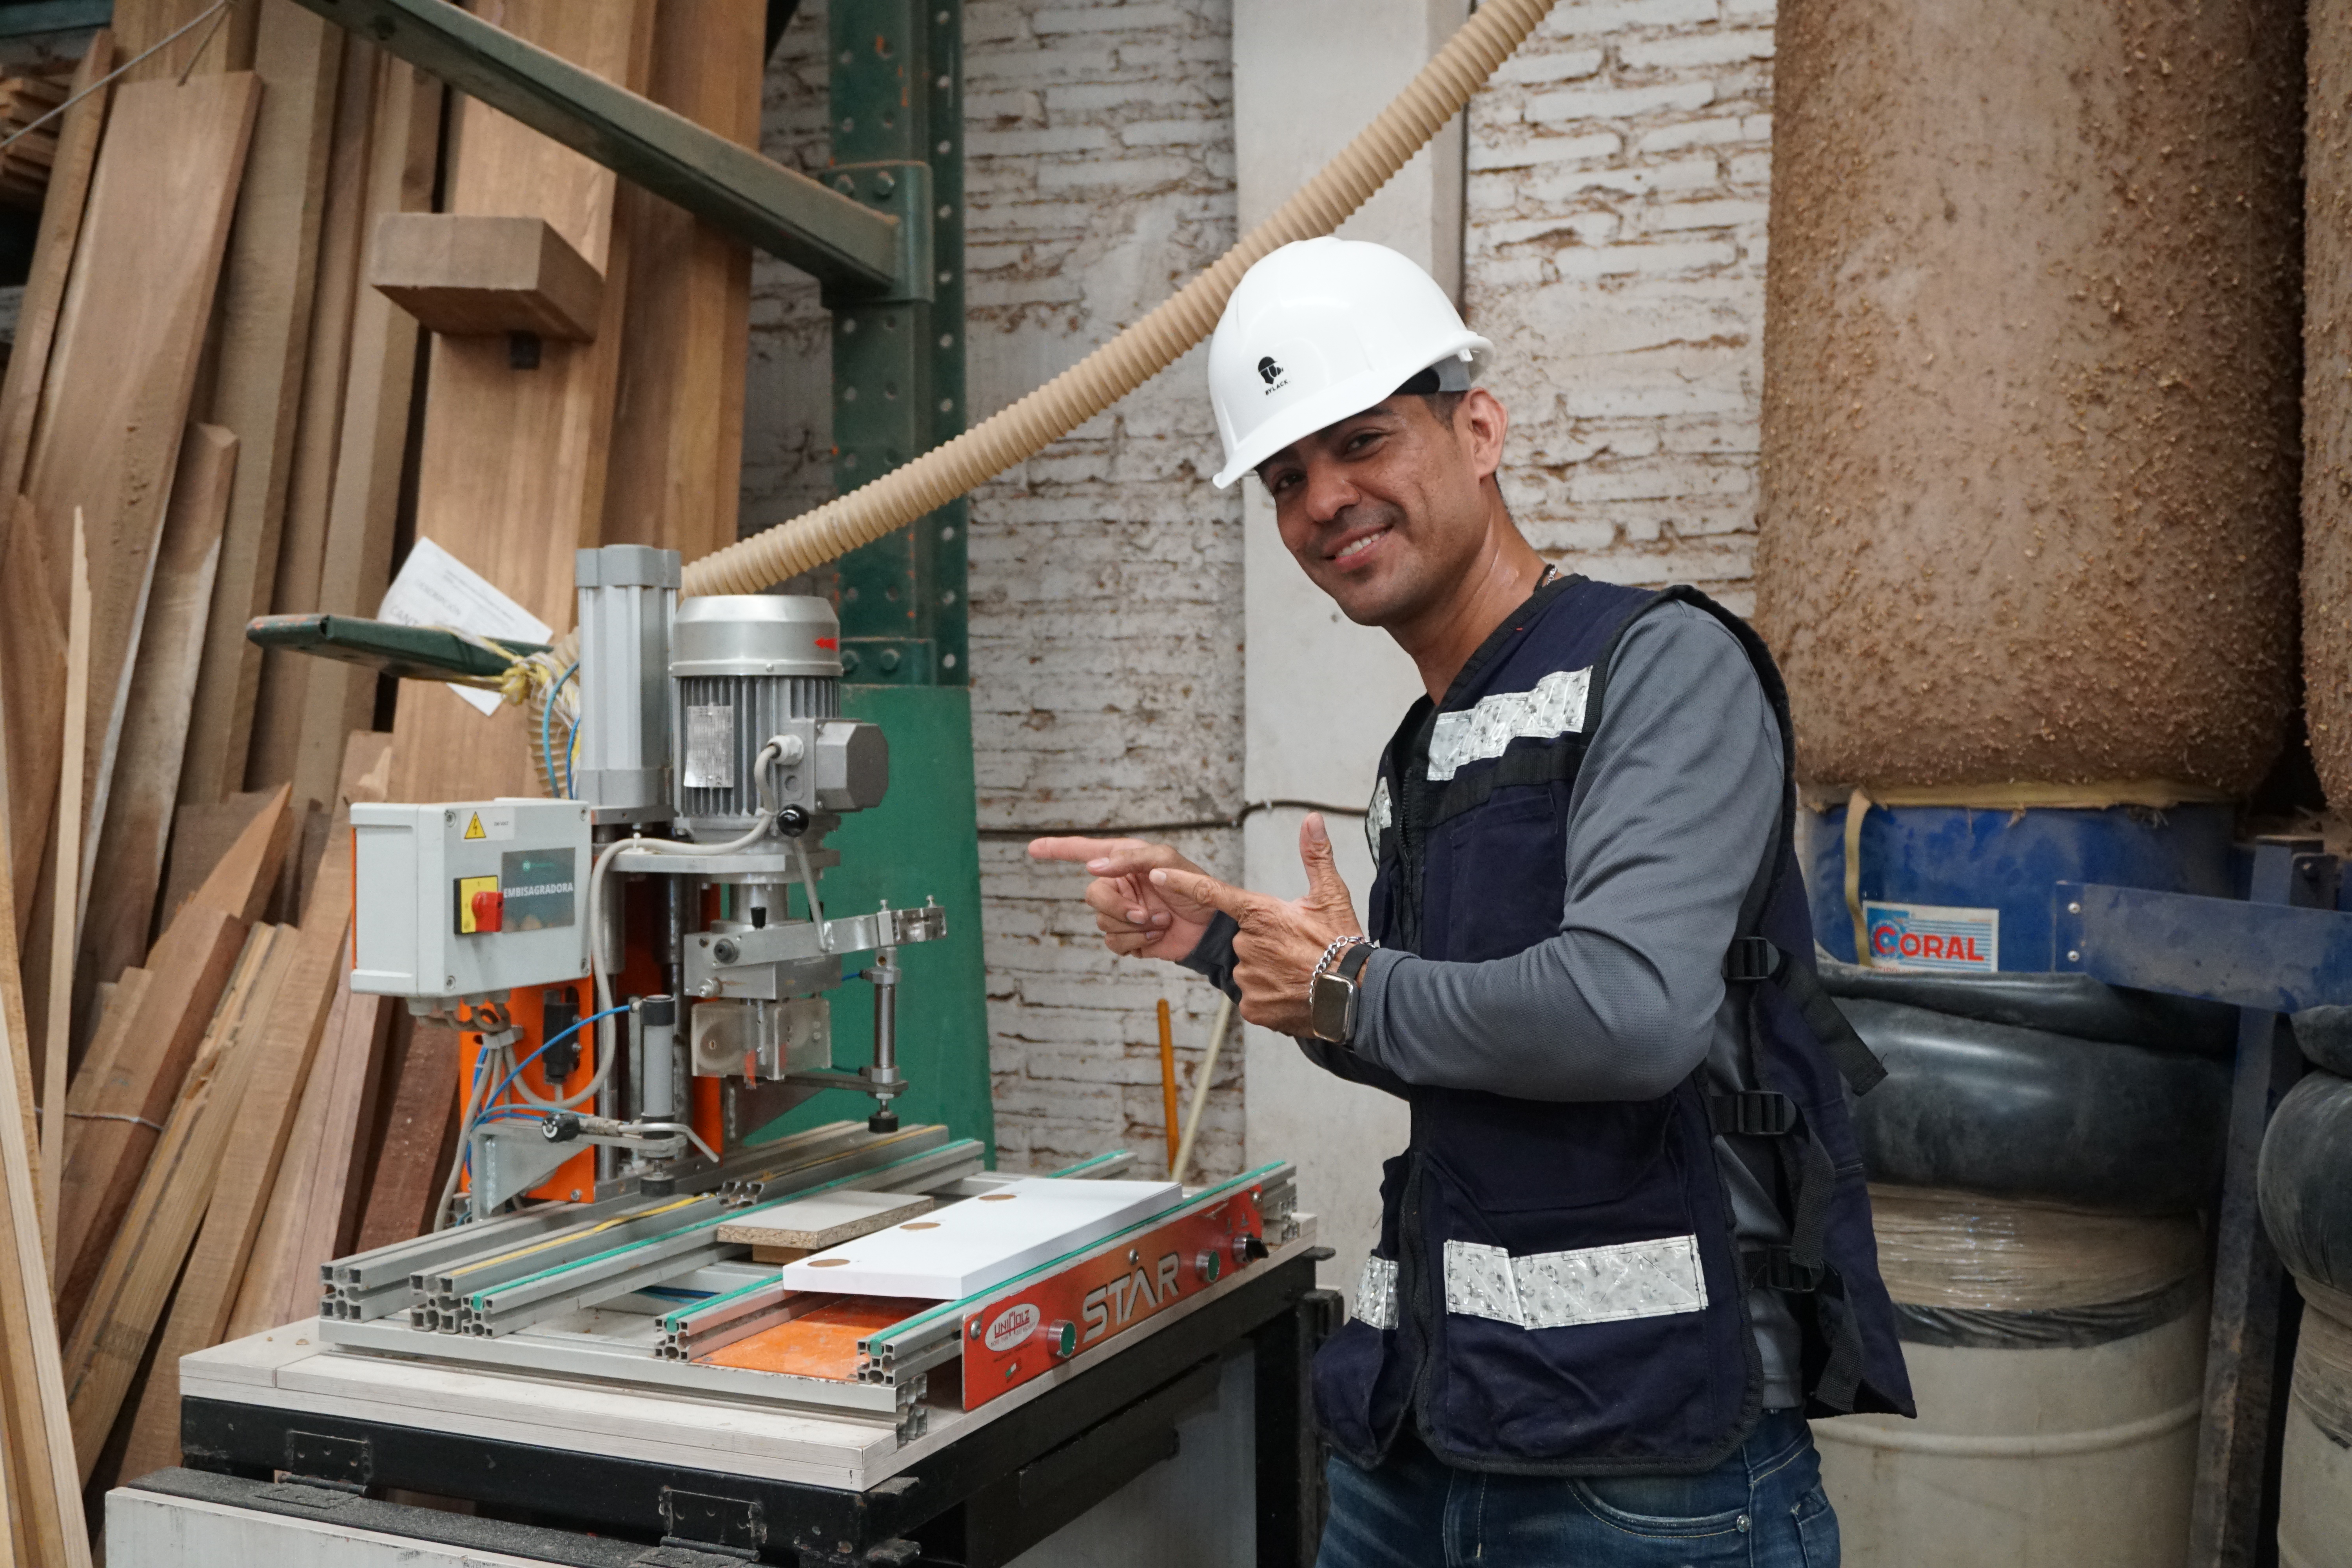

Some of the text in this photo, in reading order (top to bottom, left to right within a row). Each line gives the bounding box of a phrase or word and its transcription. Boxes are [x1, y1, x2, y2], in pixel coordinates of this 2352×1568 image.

[1265, 379, 1288, 395] BYLACK
[504, 882, 573, 898] EMBISAGRADORA
[1874, 925, 1985, 962] CORAL
[1082, 1252, 1179, 1343] STAR
